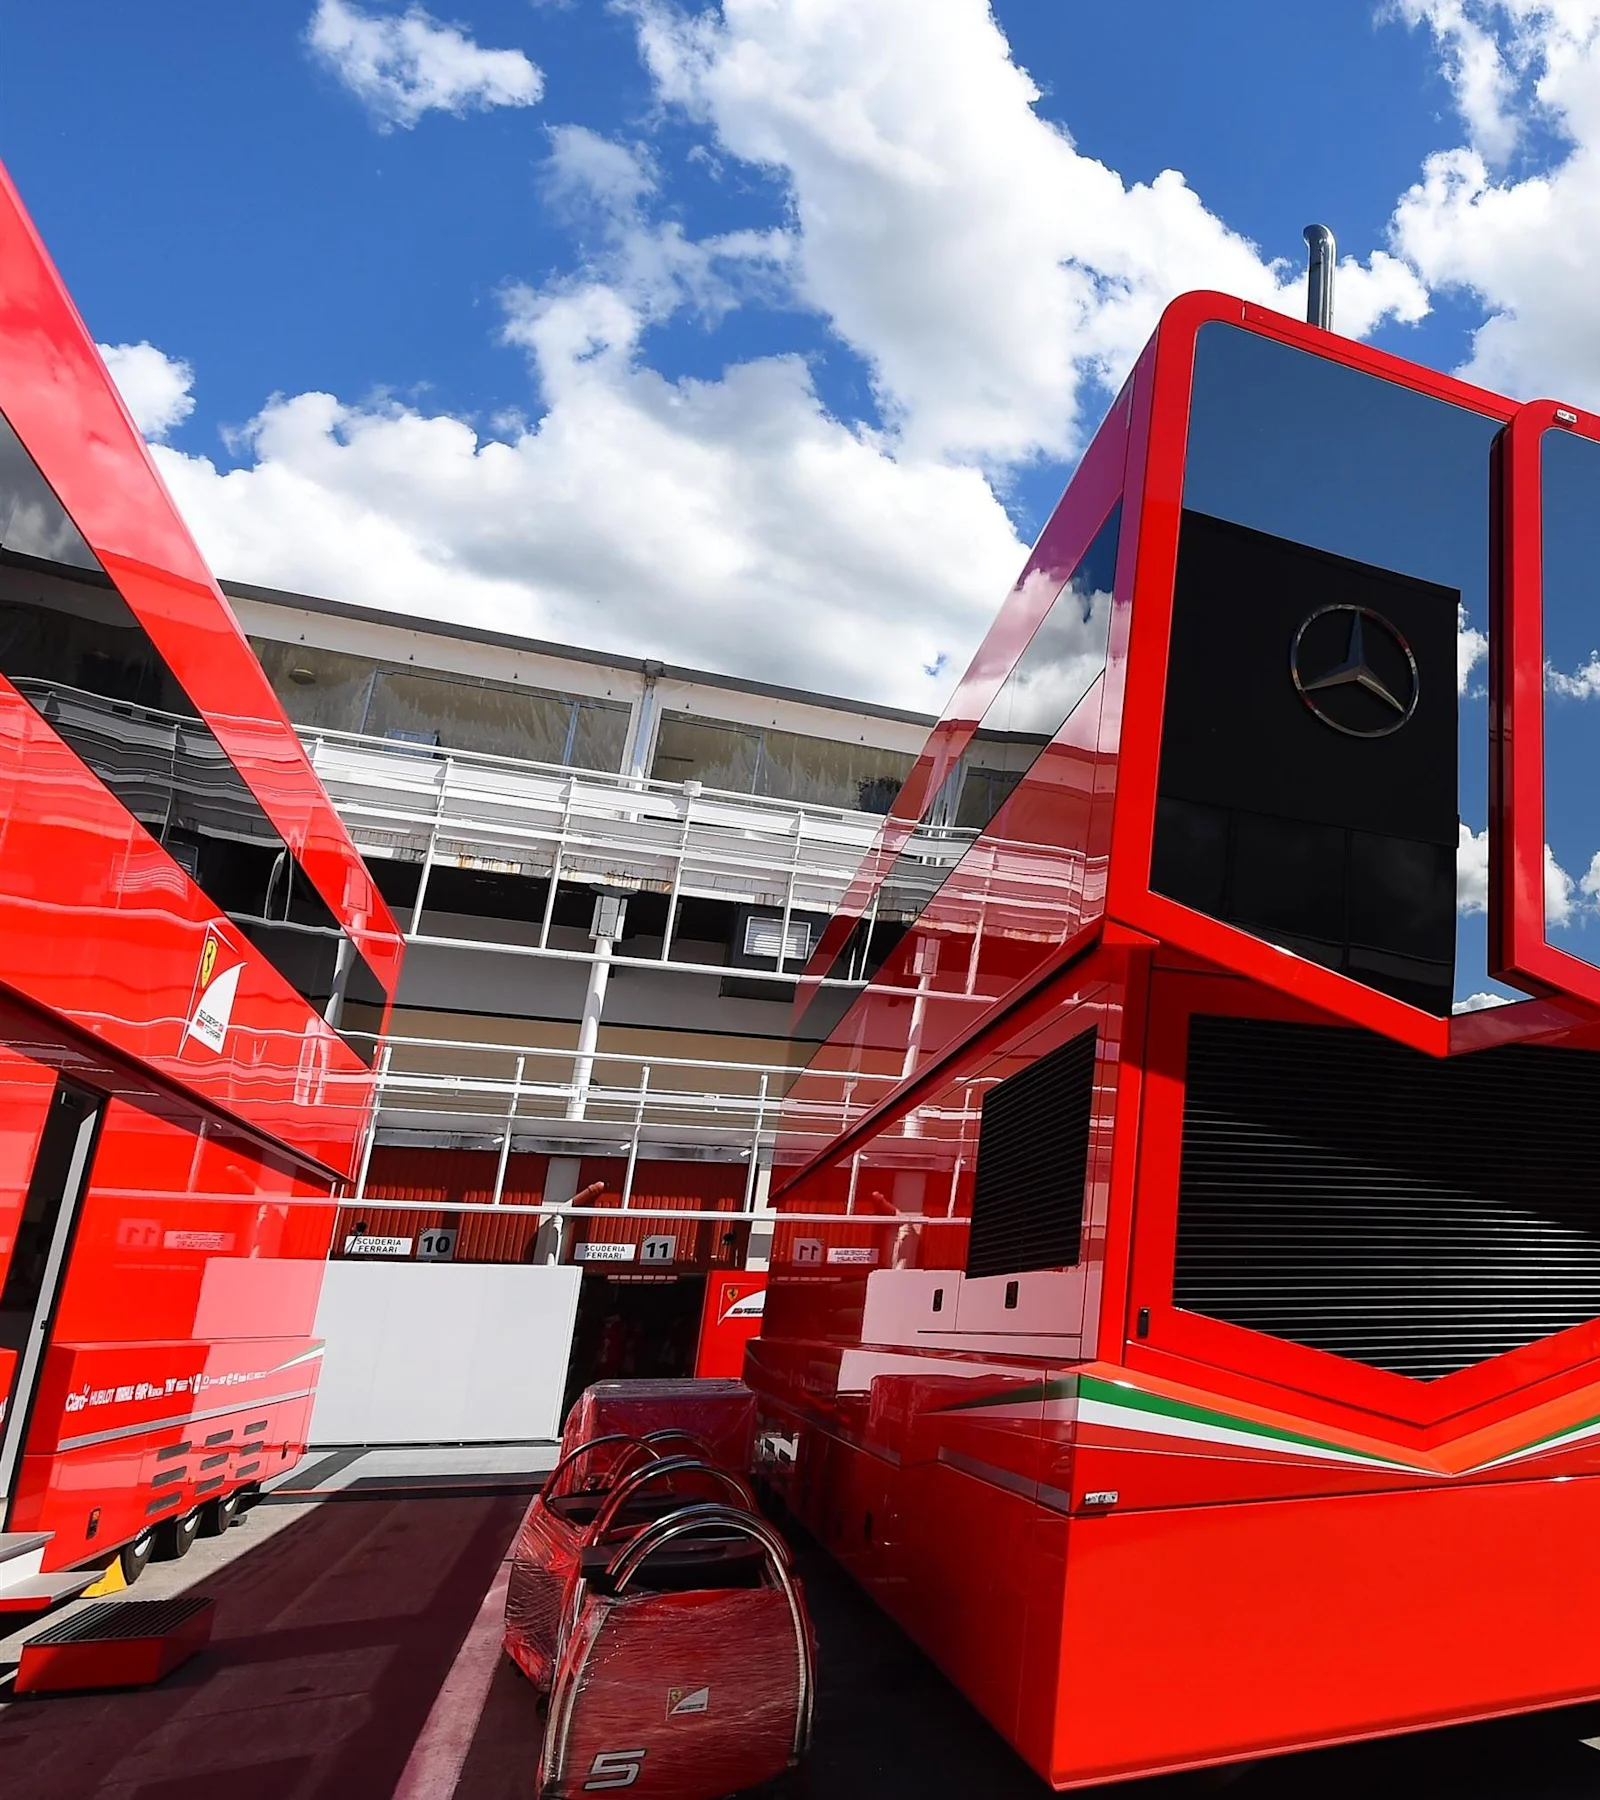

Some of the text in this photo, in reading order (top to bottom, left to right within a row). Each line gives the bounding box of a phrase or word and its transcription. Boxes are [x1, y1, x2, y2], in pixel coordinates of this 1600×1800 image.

[356, 1237, 402, 1246] SCUDERIA
[423, 1235, 451, 1253] 10
[357, 1245, 398, 1253] FERRARI
[584, 1244, 626, 1253] SCUDERIA
[646, 1242, 669, 1258] 11
[586, 1251, 623, 1259] FERRARI
[584, 1748, 648, 1792] 5
